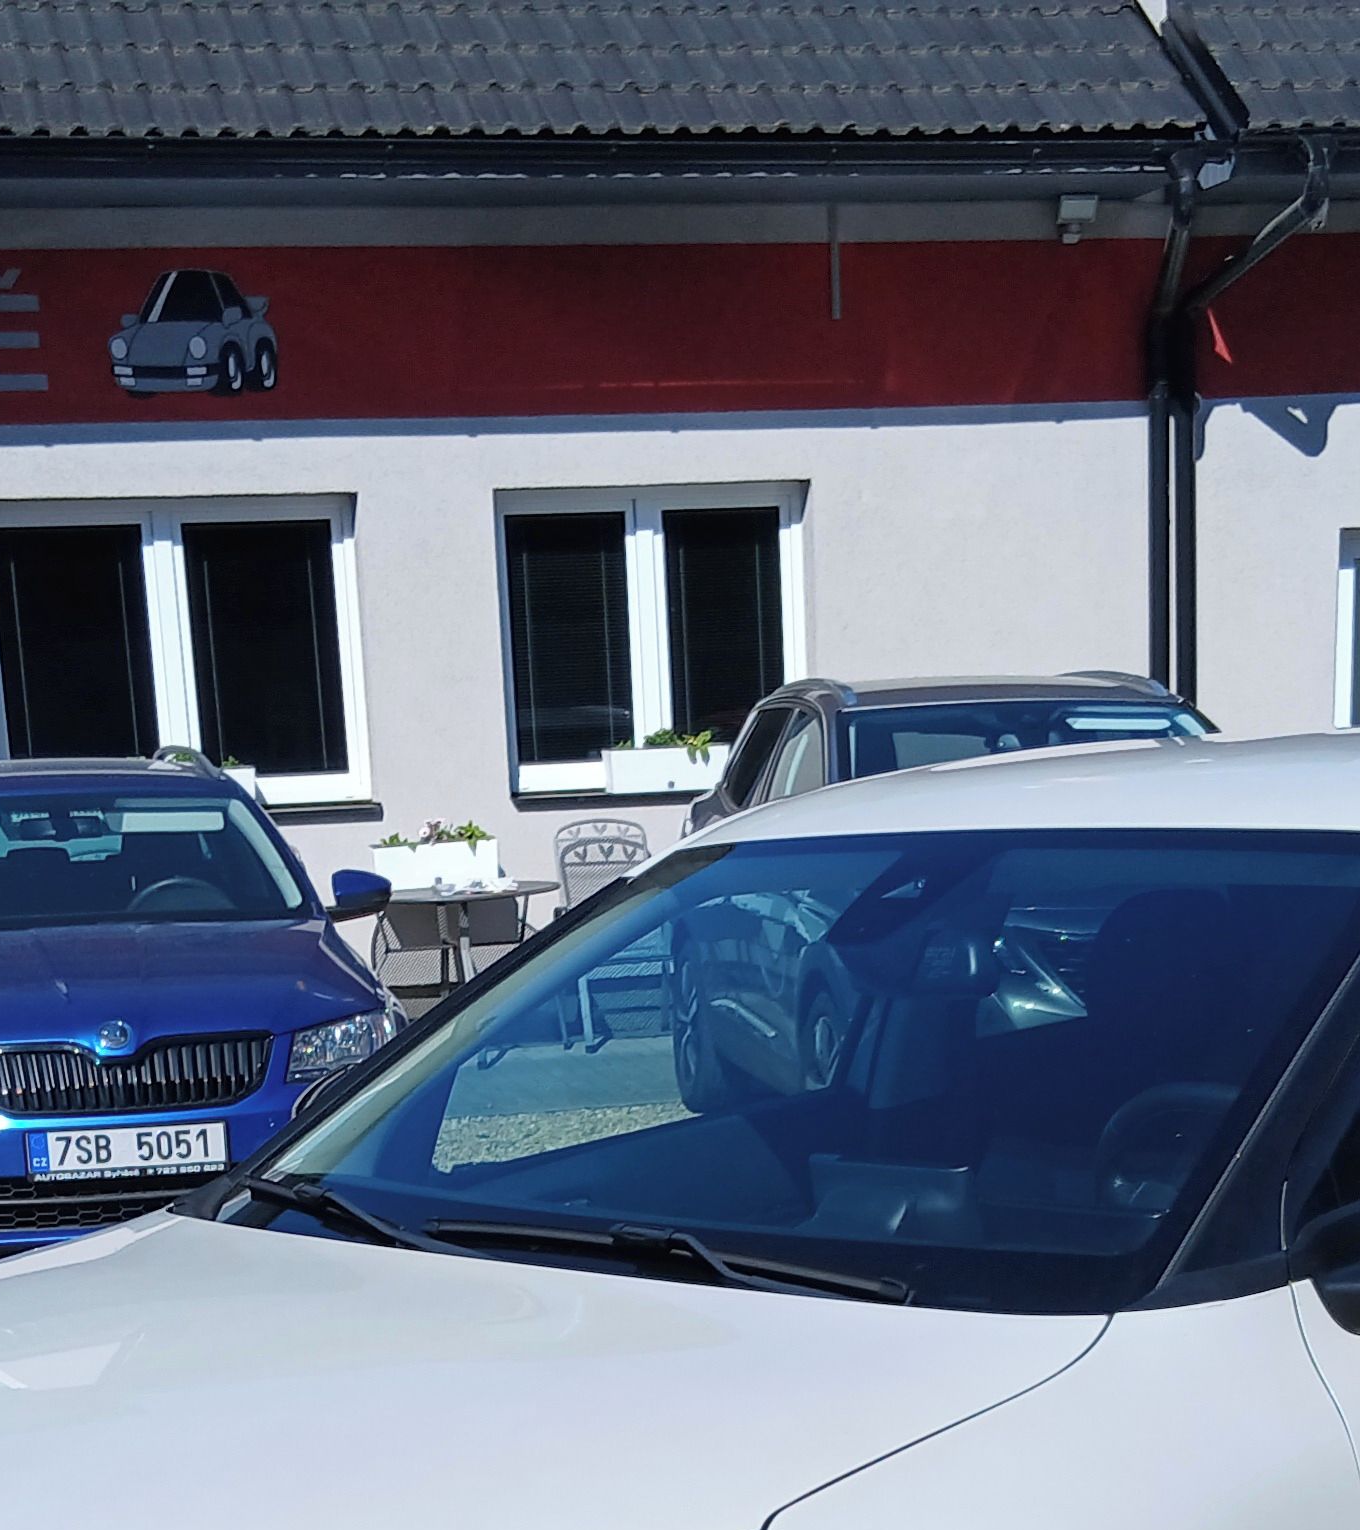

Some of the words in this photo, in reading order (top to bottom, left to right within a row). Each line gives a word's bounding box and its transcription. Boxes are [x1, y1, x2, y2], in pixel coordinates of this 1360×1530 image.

[55, 1134, 112, 1166] 7SB
[136, 1128, 209, 1161] 5051
[33, 1157, 48, 1168] CZ
